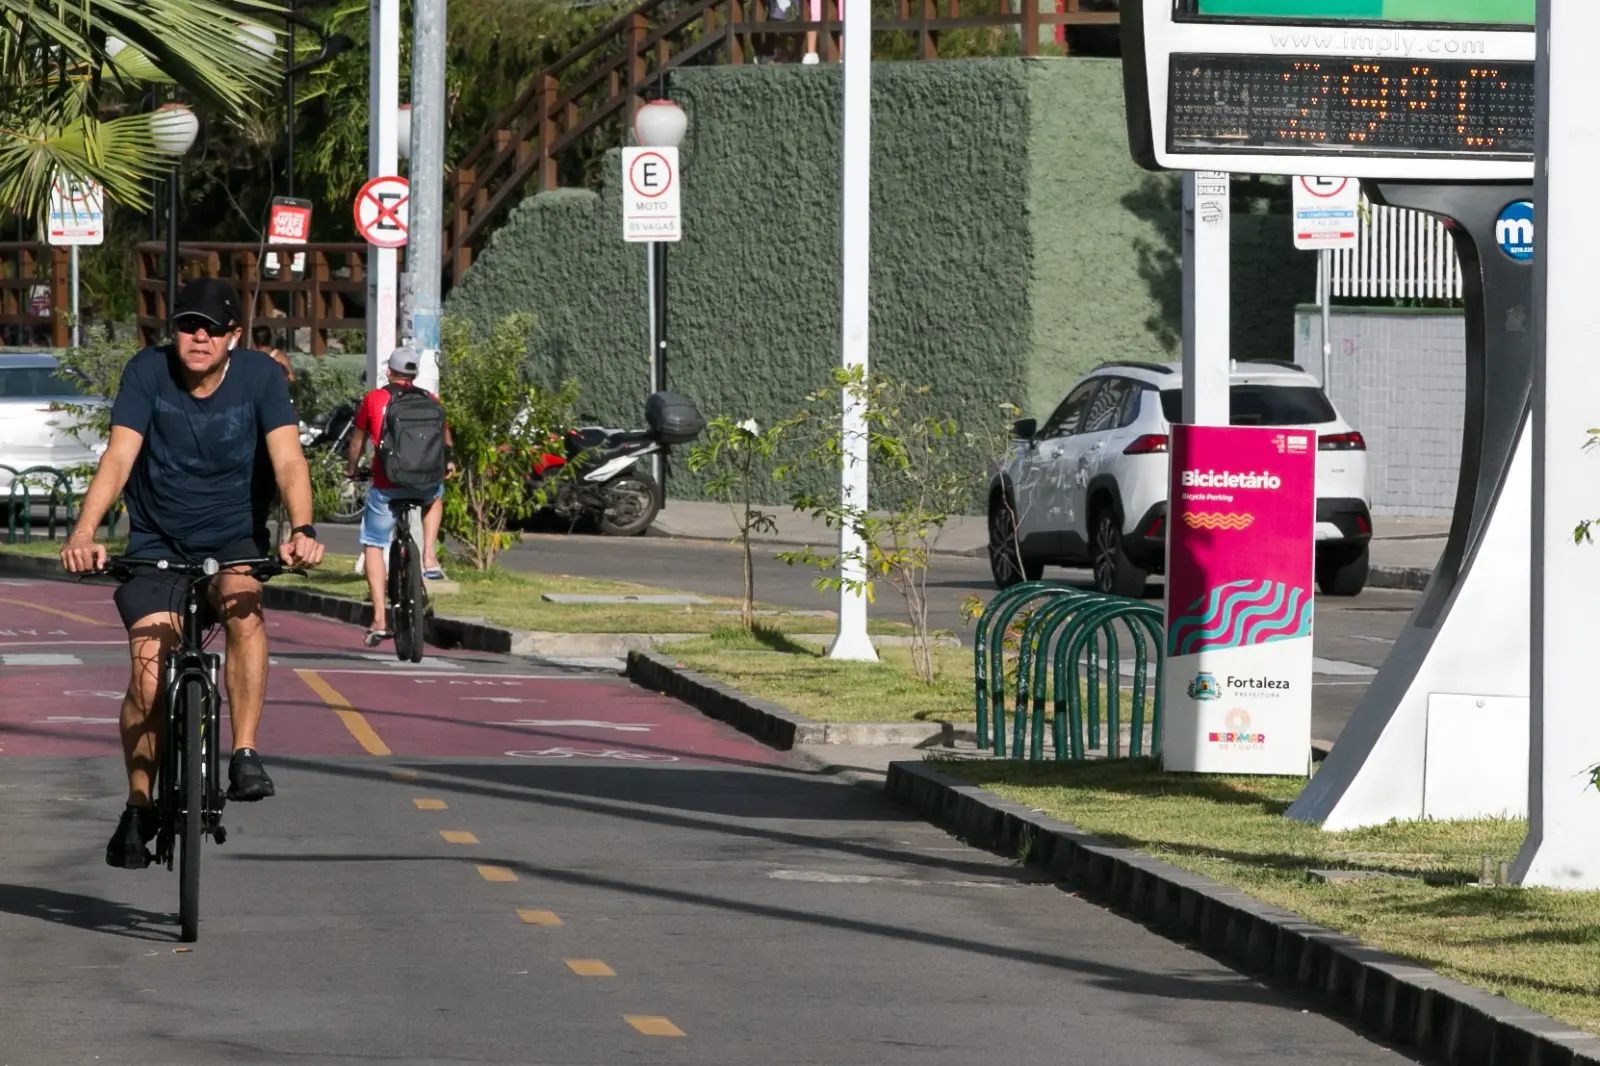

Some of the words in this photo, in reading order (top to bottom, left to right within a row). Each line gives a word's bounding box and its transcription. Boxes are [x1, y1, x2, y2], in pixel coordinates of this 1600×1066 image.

[1269, 31, 1485, 57] www.imply.com
[644, 162, 658, 187] E
[636, 201, 668, 211] MOTO
[1181, 469, 1281, 490] Bicicletário
[1181, 493, 1206, 501] Bicycle
[1206, 493, 1234, 503] Parking
[1227, 676, 1290, 690] Fortaleza
